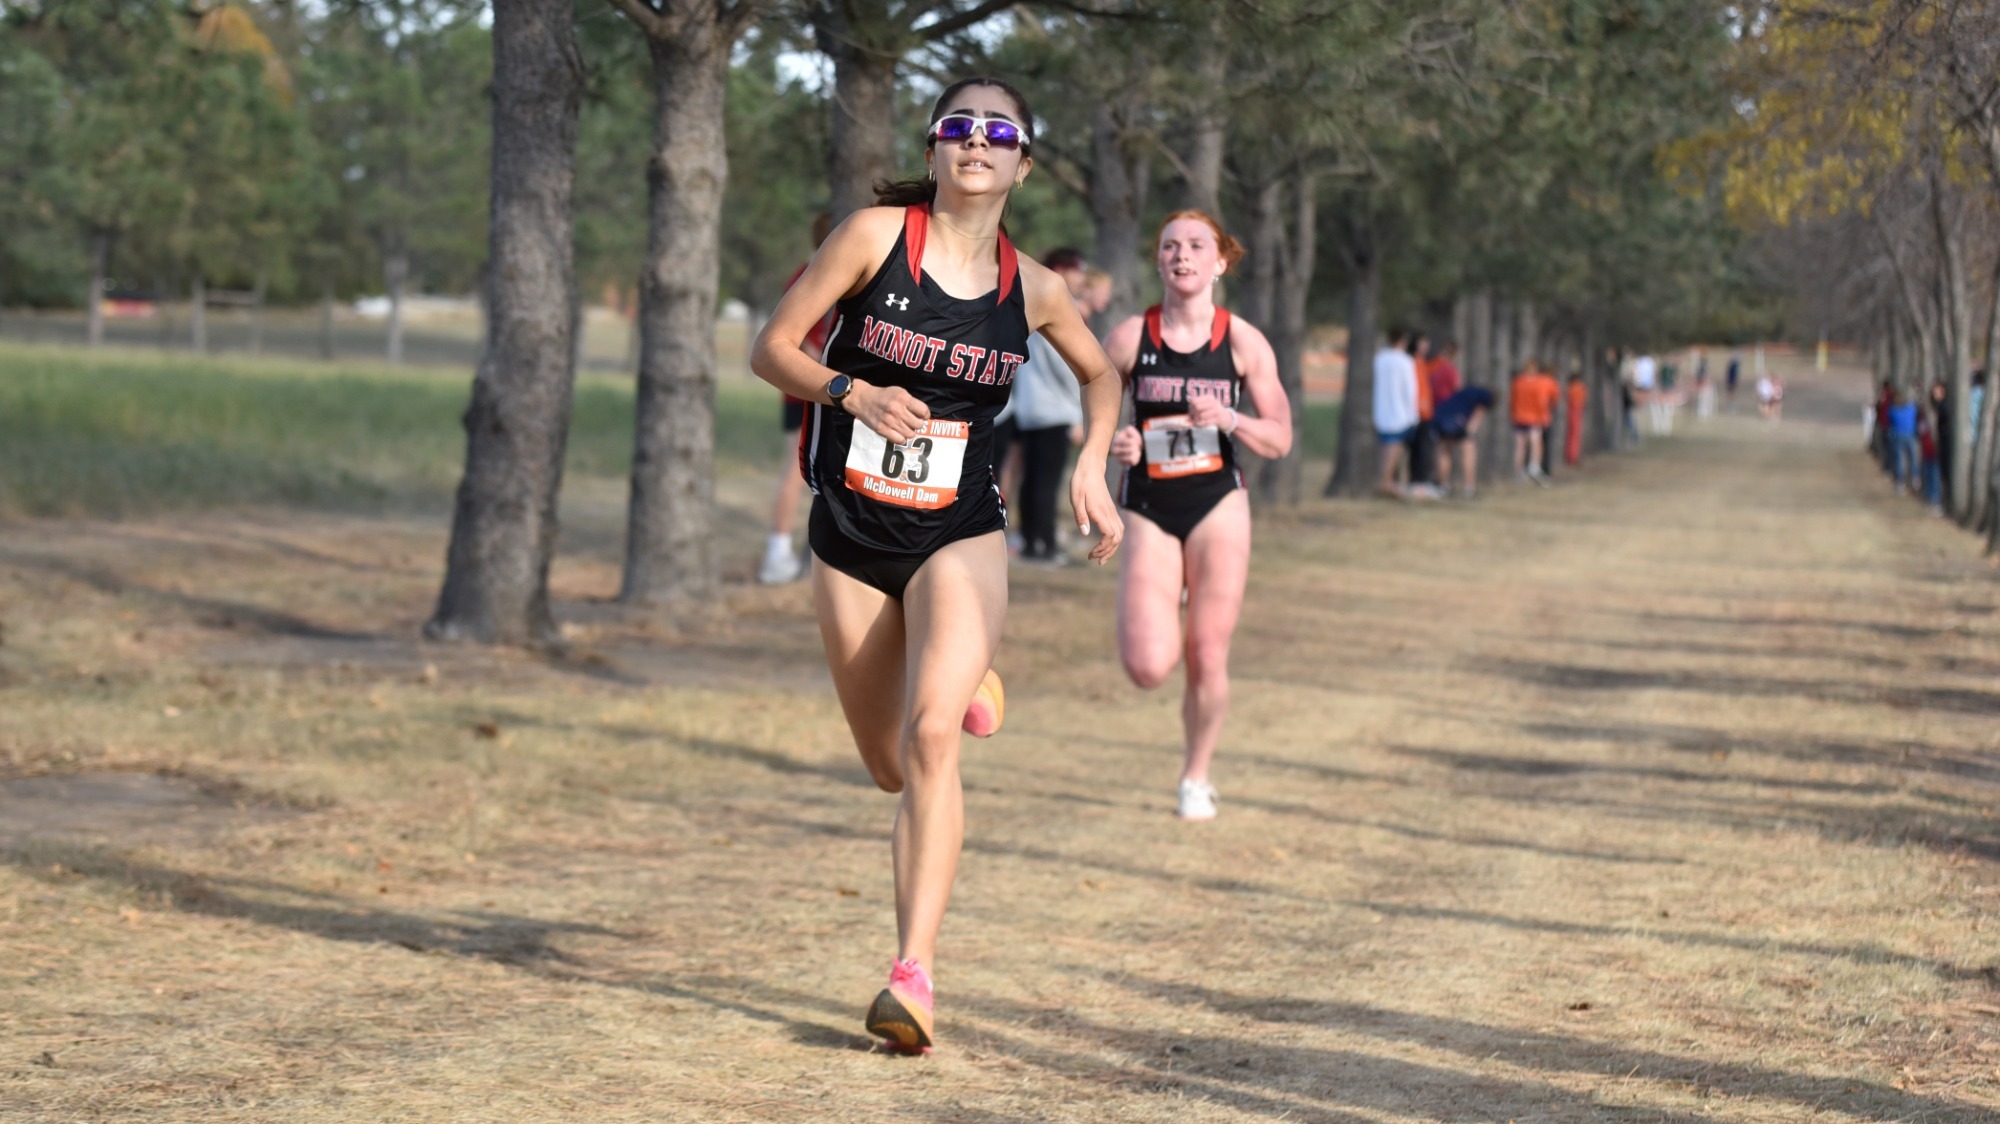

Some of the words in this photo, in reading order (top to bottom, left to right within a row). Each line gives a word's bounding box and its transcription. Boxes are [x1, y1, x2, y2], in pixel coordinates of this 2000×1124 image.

[858, 316, 945, 372] MINOT
[930, 421, 961, 437] INVITE
[1166, 430, 1197, 458] 71
[882, 437, 933, 483] 63
[863, 476, 914, 499] McDowell
[916, 489, 939, 503] Dam
